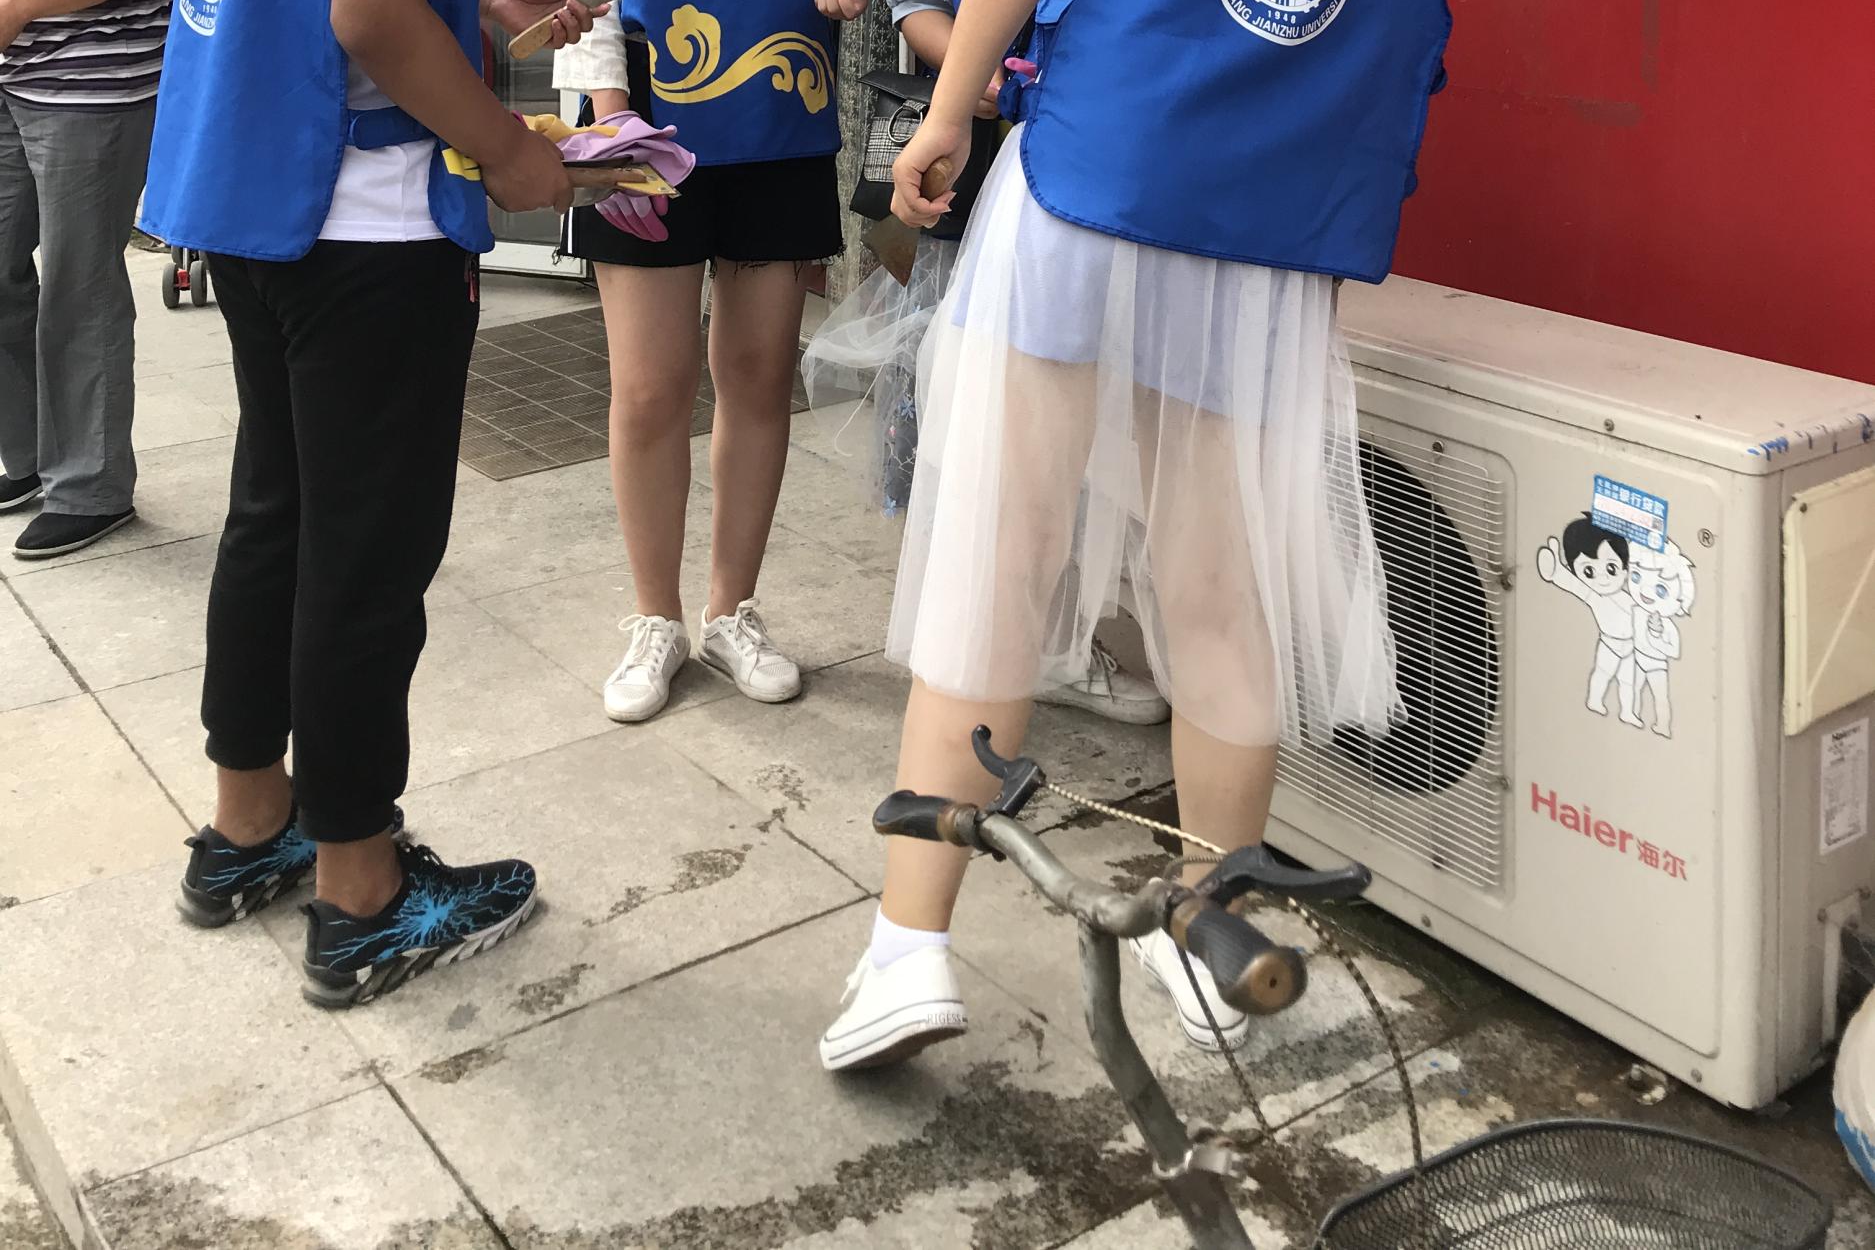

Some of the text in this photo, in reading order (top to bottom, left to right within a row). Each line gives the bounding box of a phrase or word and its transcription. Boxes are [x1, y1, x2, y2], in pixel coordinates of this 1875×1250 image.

[1252, 14, 1300, 40] JIANZHU
[1266, 9, 1298, 26] 1948
[1531, 781, 1688, 881] Haier 海尔
